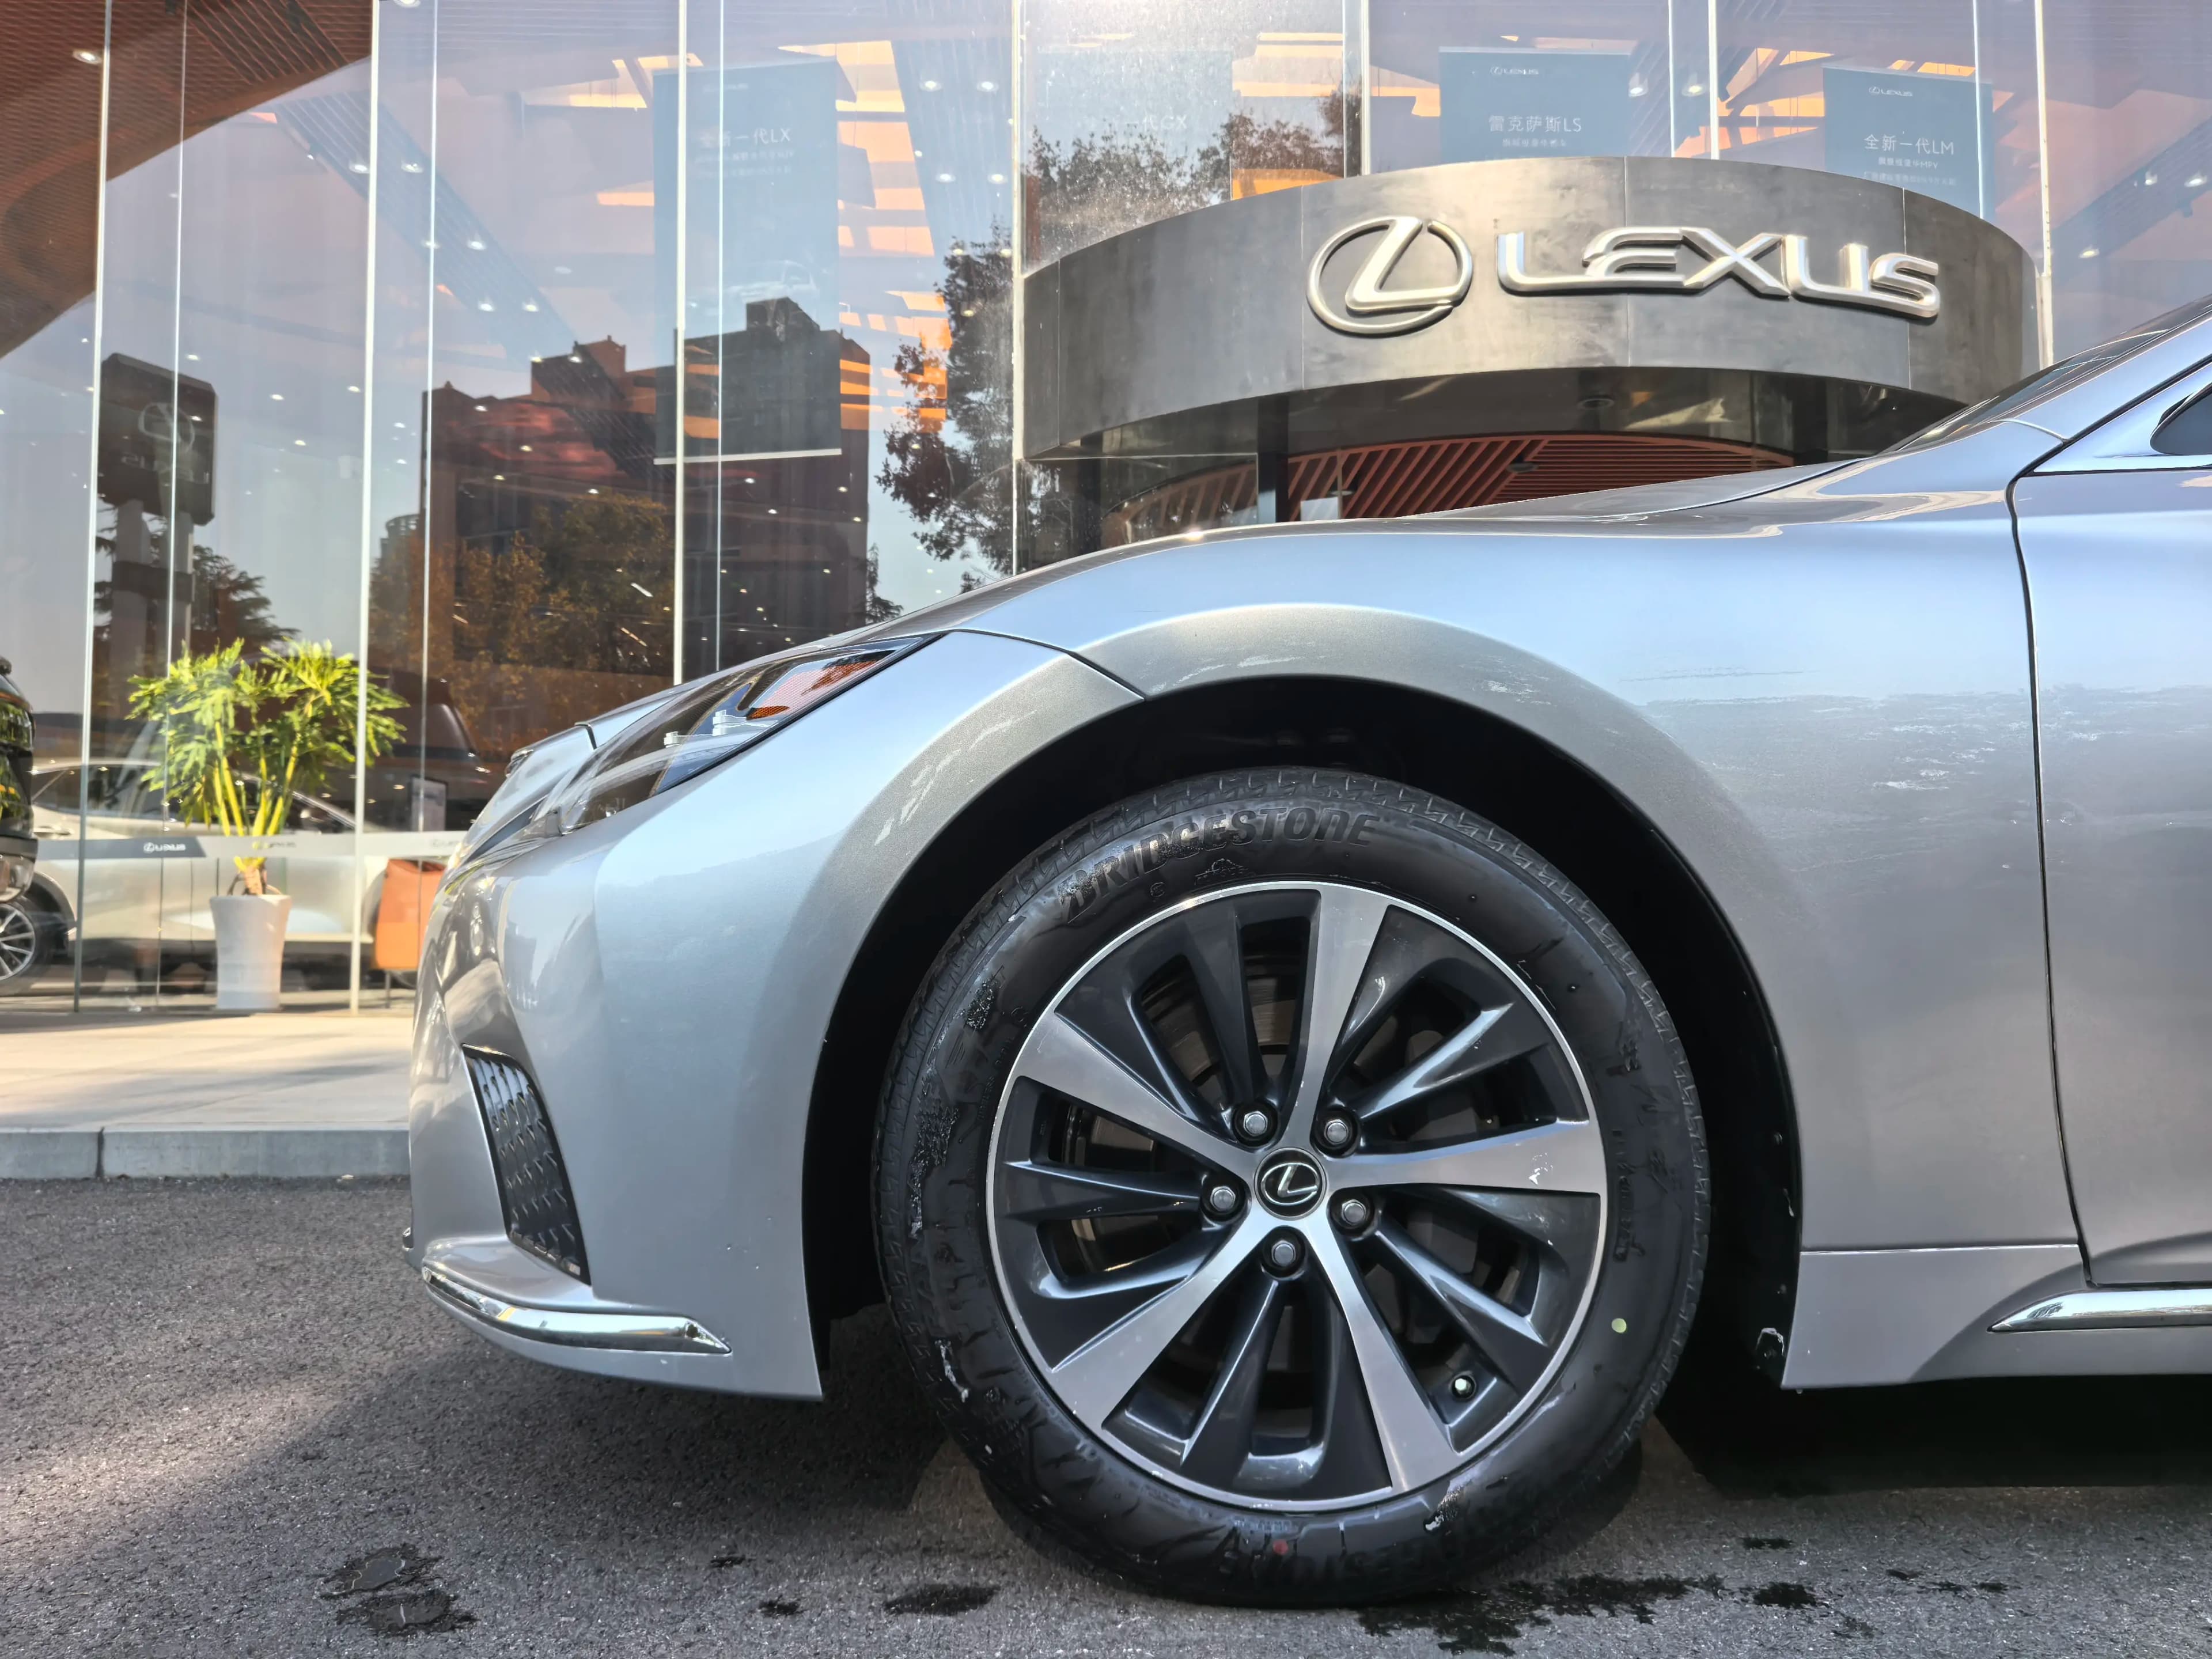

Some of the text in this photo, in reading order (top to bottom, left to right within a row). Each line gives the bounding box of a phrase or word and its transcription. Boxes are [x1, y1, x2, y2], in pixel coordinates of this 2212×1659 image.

[1488, 115, 1582, 133] 雷克萨斯LS
[1863, 134, 1955, 155] 全新一代LM
[1497, 226, 1940, 317] LEXUS
